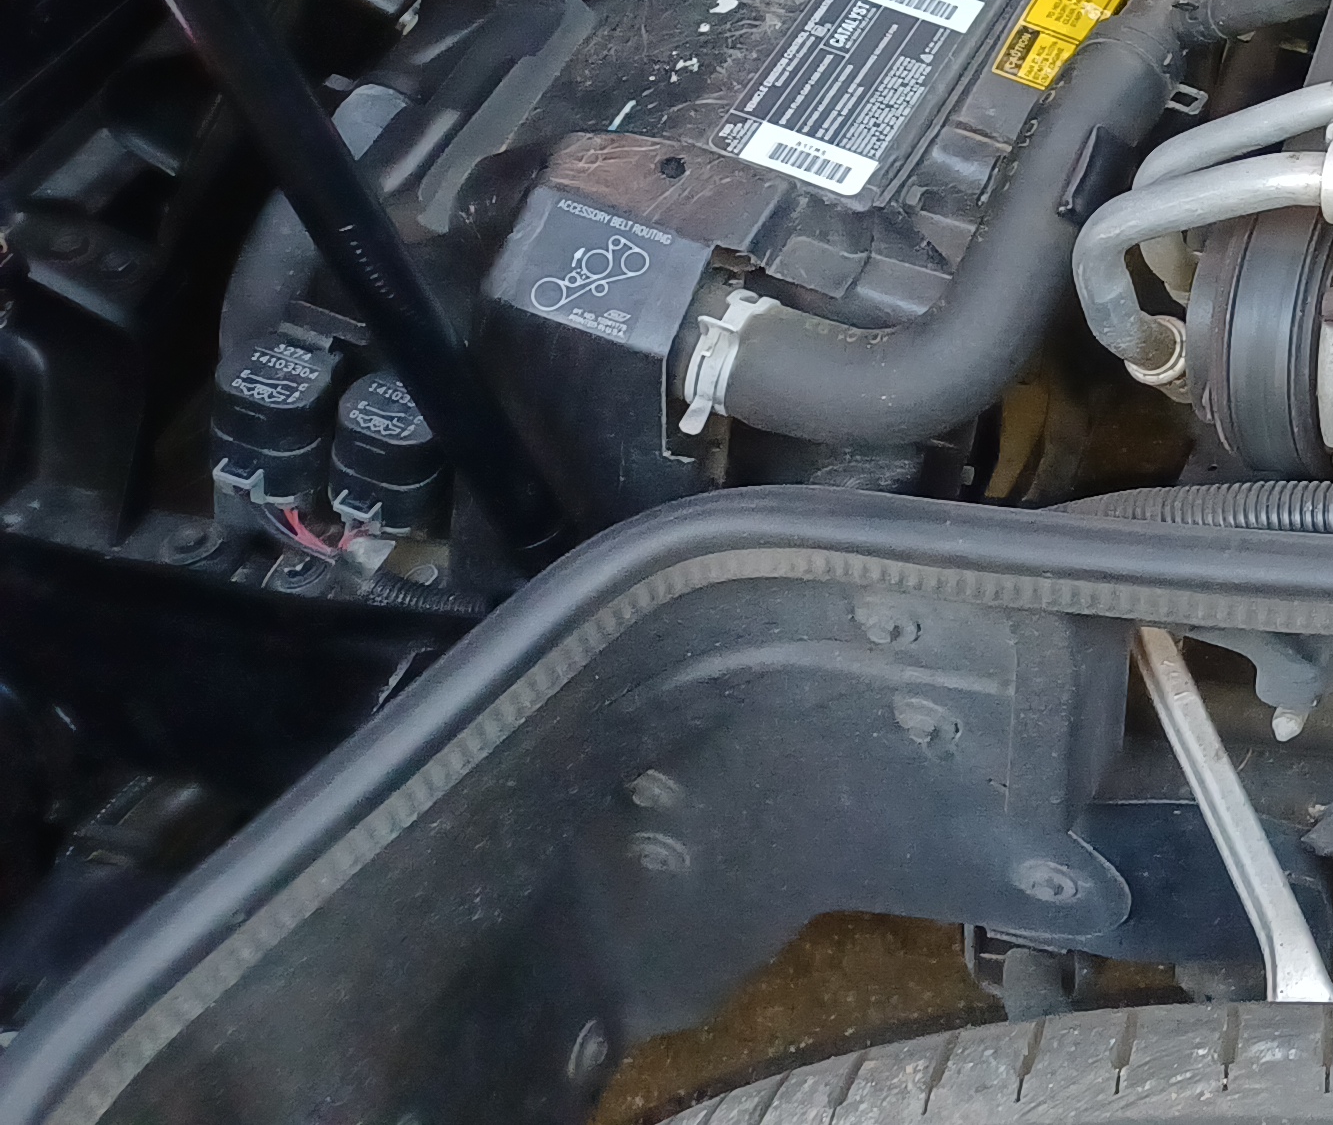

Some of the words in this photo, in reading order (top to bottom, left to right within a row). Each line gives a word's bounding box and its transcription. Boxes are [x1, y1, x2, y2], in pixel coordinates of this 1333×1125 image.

[828, 0, 870, 47] CATALYST
[1003, 32, 1031, 67] CAUTION
[557, 197, 611, 223] ACCESSORY
[609, 216, 633, 232] BELT
[631, 223, 672, 245] ROUTING
[251, 351, 319, 379] 14103304
